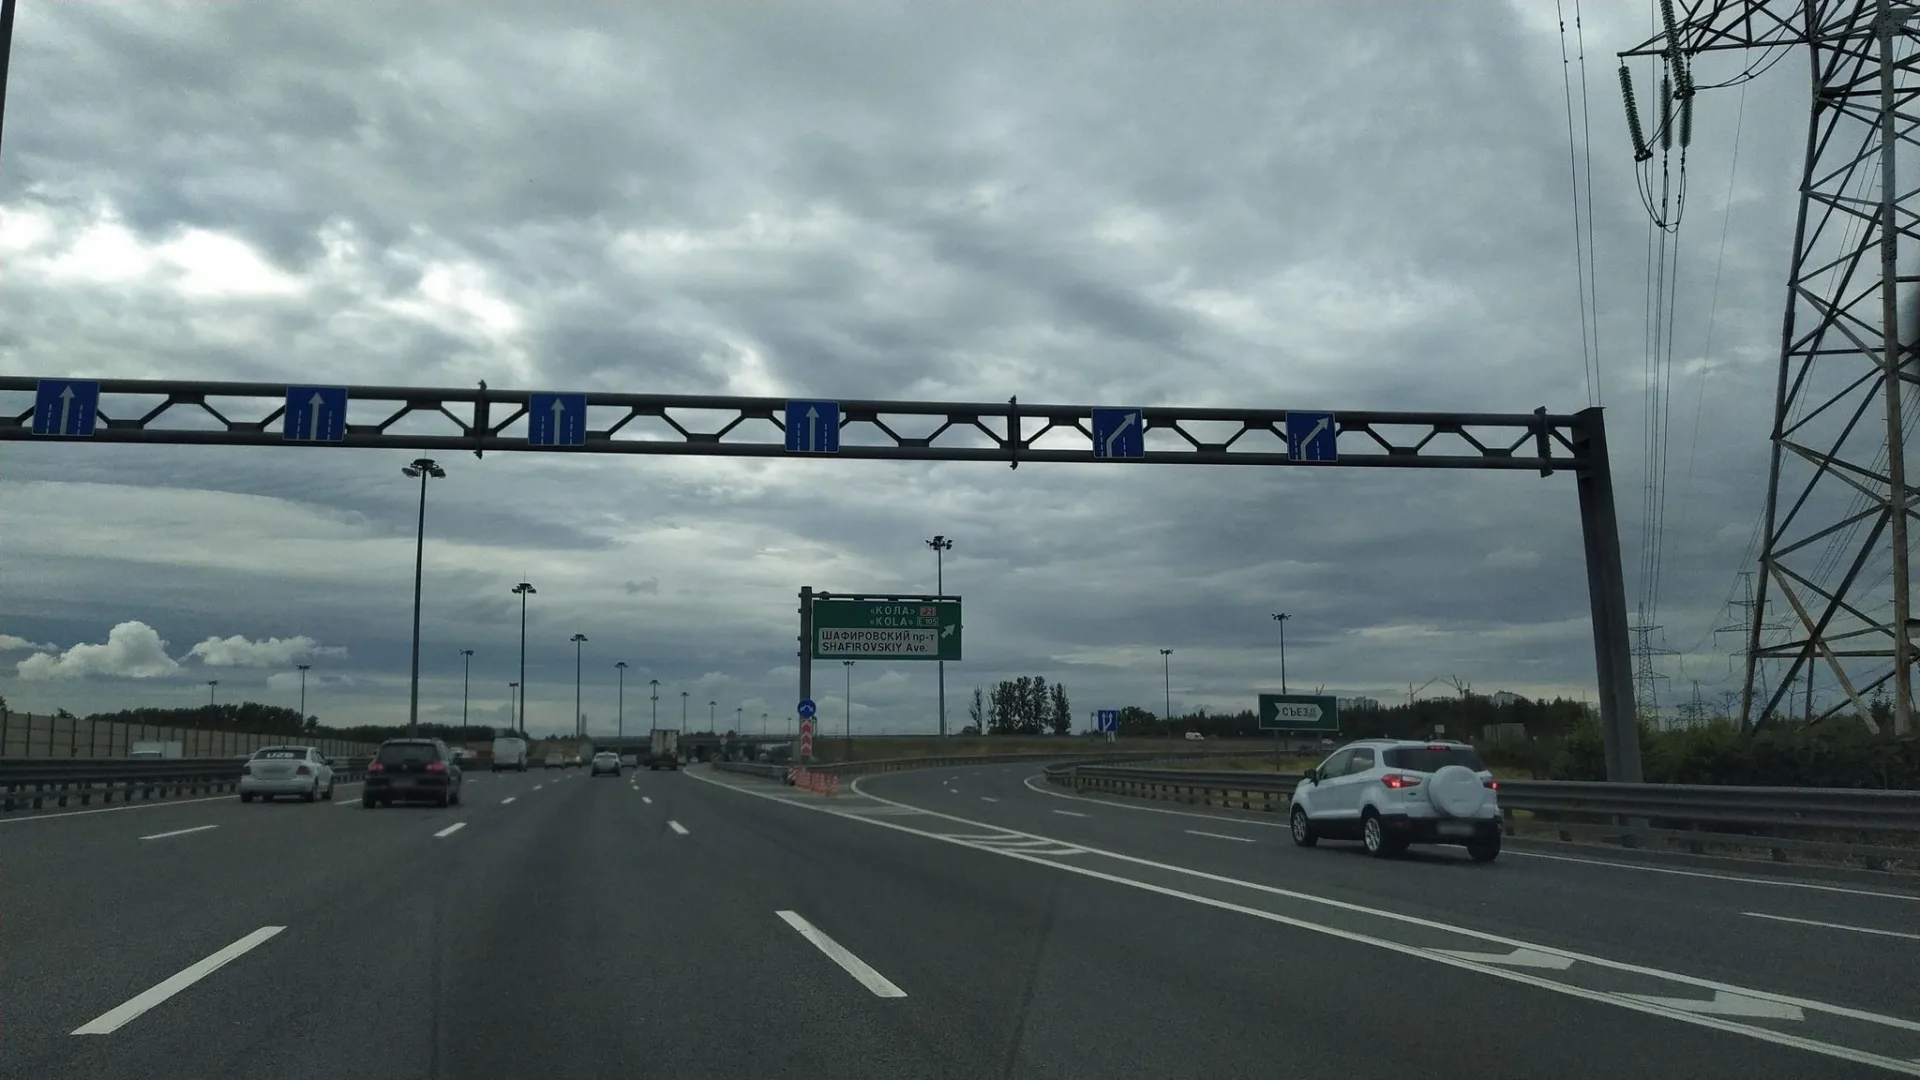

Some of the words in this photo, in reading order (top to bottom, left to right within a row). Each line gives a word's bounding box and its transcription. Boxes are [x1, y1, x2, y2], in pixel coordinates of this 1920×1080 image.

[870, 606, 915, 615] «КОЛА»
[870, 616, 914, 626] «KOLA»
[822, 630, 910, 641] ШАФИРОВСКИЙ
[912, 633, 935, 643] пр-т
[822, 642, 902, 652] SHAFIROVSKIY
[905, 643, 928, 652] Ave.
